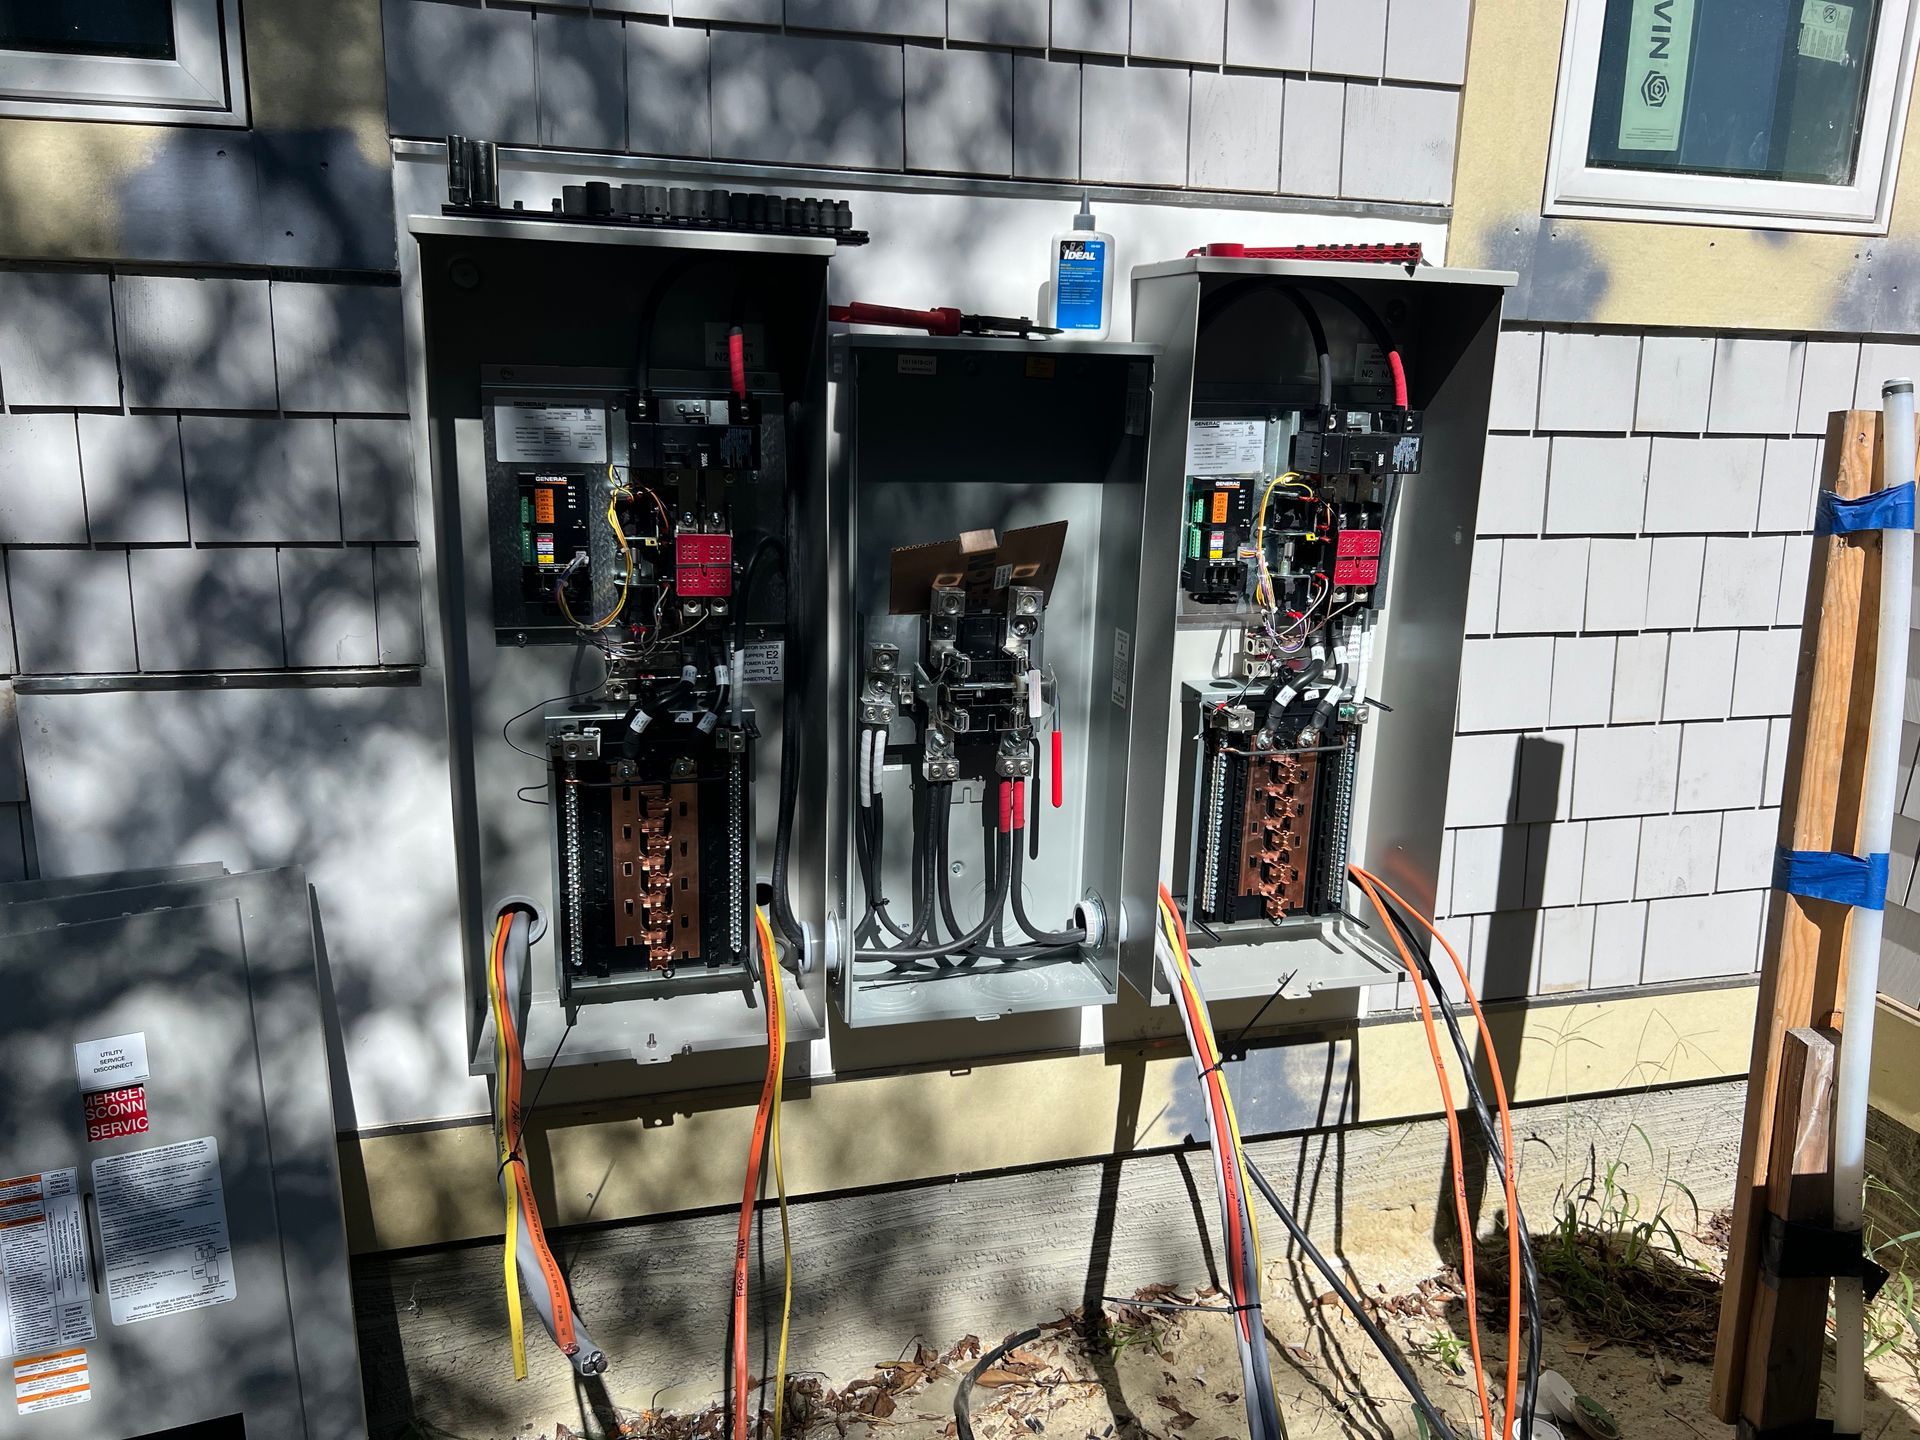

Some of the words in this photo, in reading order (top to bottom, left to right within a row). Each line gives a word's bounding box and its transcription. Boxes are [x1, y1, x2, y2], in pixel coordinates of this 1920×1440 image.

[1649, 0, 1674, 59] VIN
[1064, 250, 1096, 260] IDEAL
[766, 650, 779, 659] E2
[766, 666, 779, 674] T2
[100, 1049, 123, 1057] UTILITY
[100, 1056, 125, 1065] SERVICE
[94, 1062, 133, 1073] DISCONNECT
[736, 1271, 746, 1298] FROG
